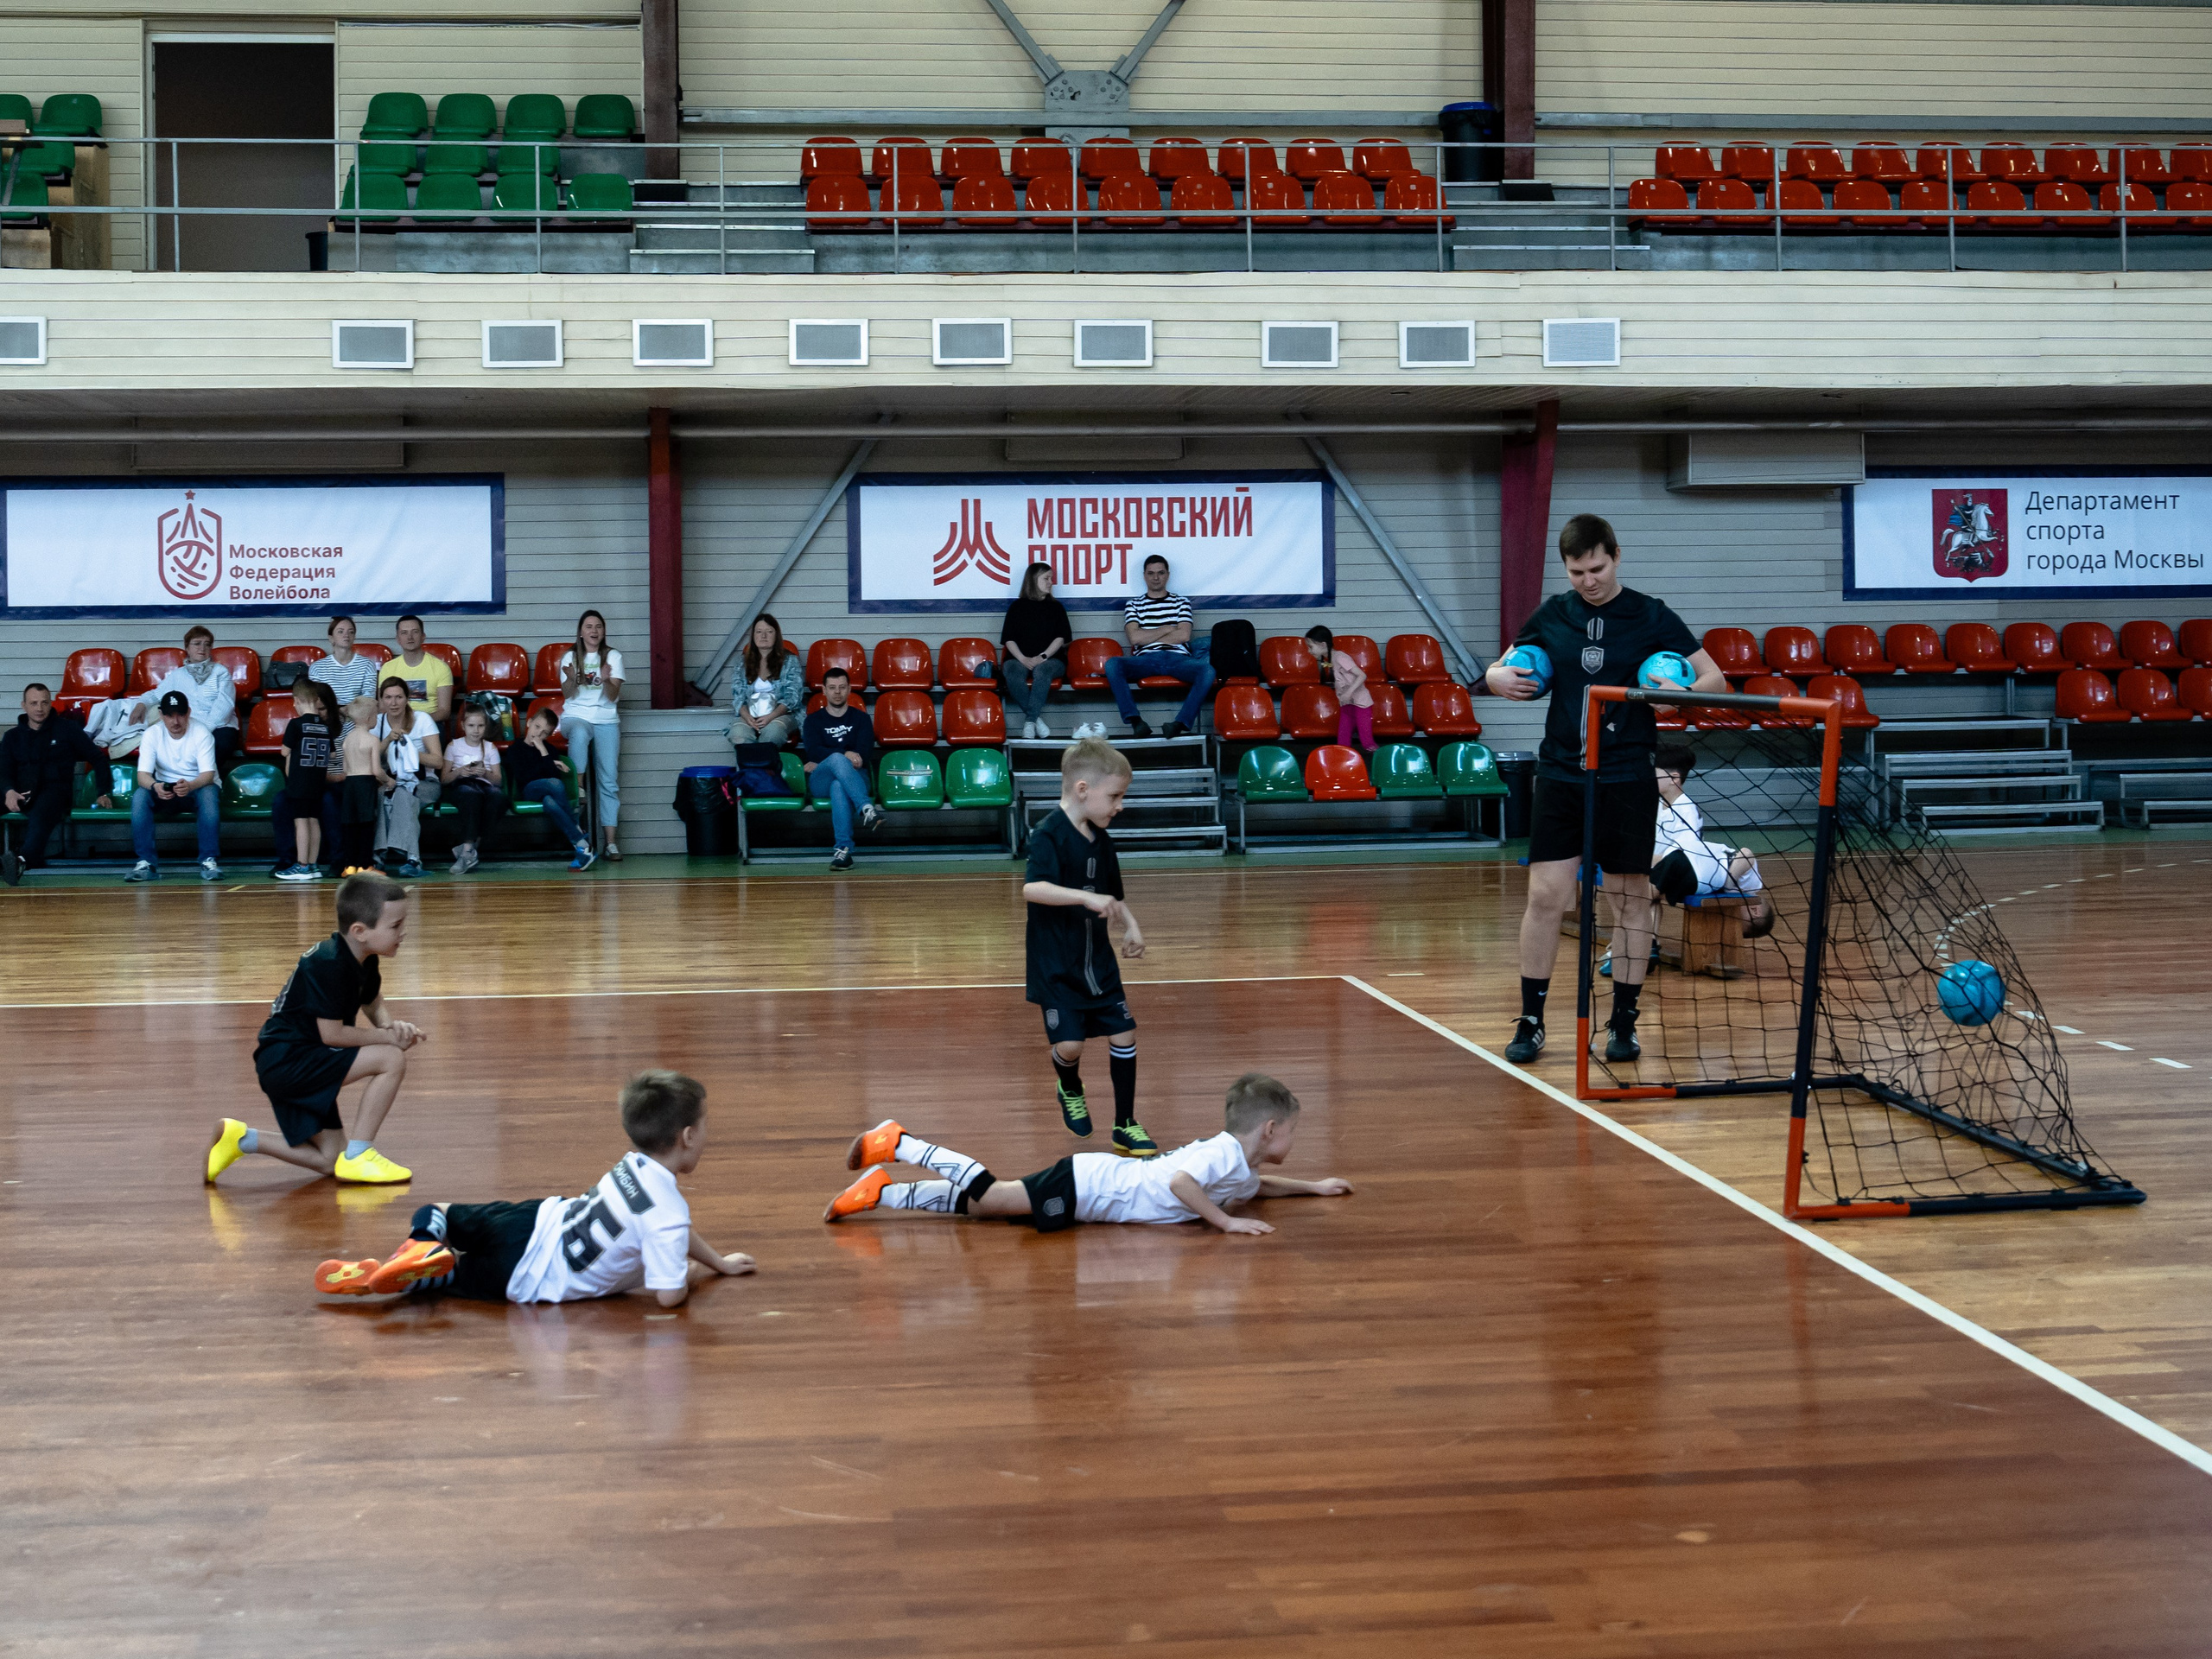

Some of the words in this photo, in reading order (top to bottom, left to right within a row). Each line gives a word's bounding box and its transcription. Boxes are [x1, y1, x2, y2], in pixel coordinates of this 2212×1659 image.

[1027, 487, 1253, 538] МОСКОВСКИЙ
[2025, 491, 2180, 516] Департамент
[2026, 524, 2105, 545] спорта
[229, 544, 343, 558] Московская
[2027, 553, 2107, 575] города
[2114, 550, 2203, 569] Москвы
[230, 565, 335, 582] Федерация
[230, 585, 331, 600] Волейбола
[300, 737, 330, 767] 59
